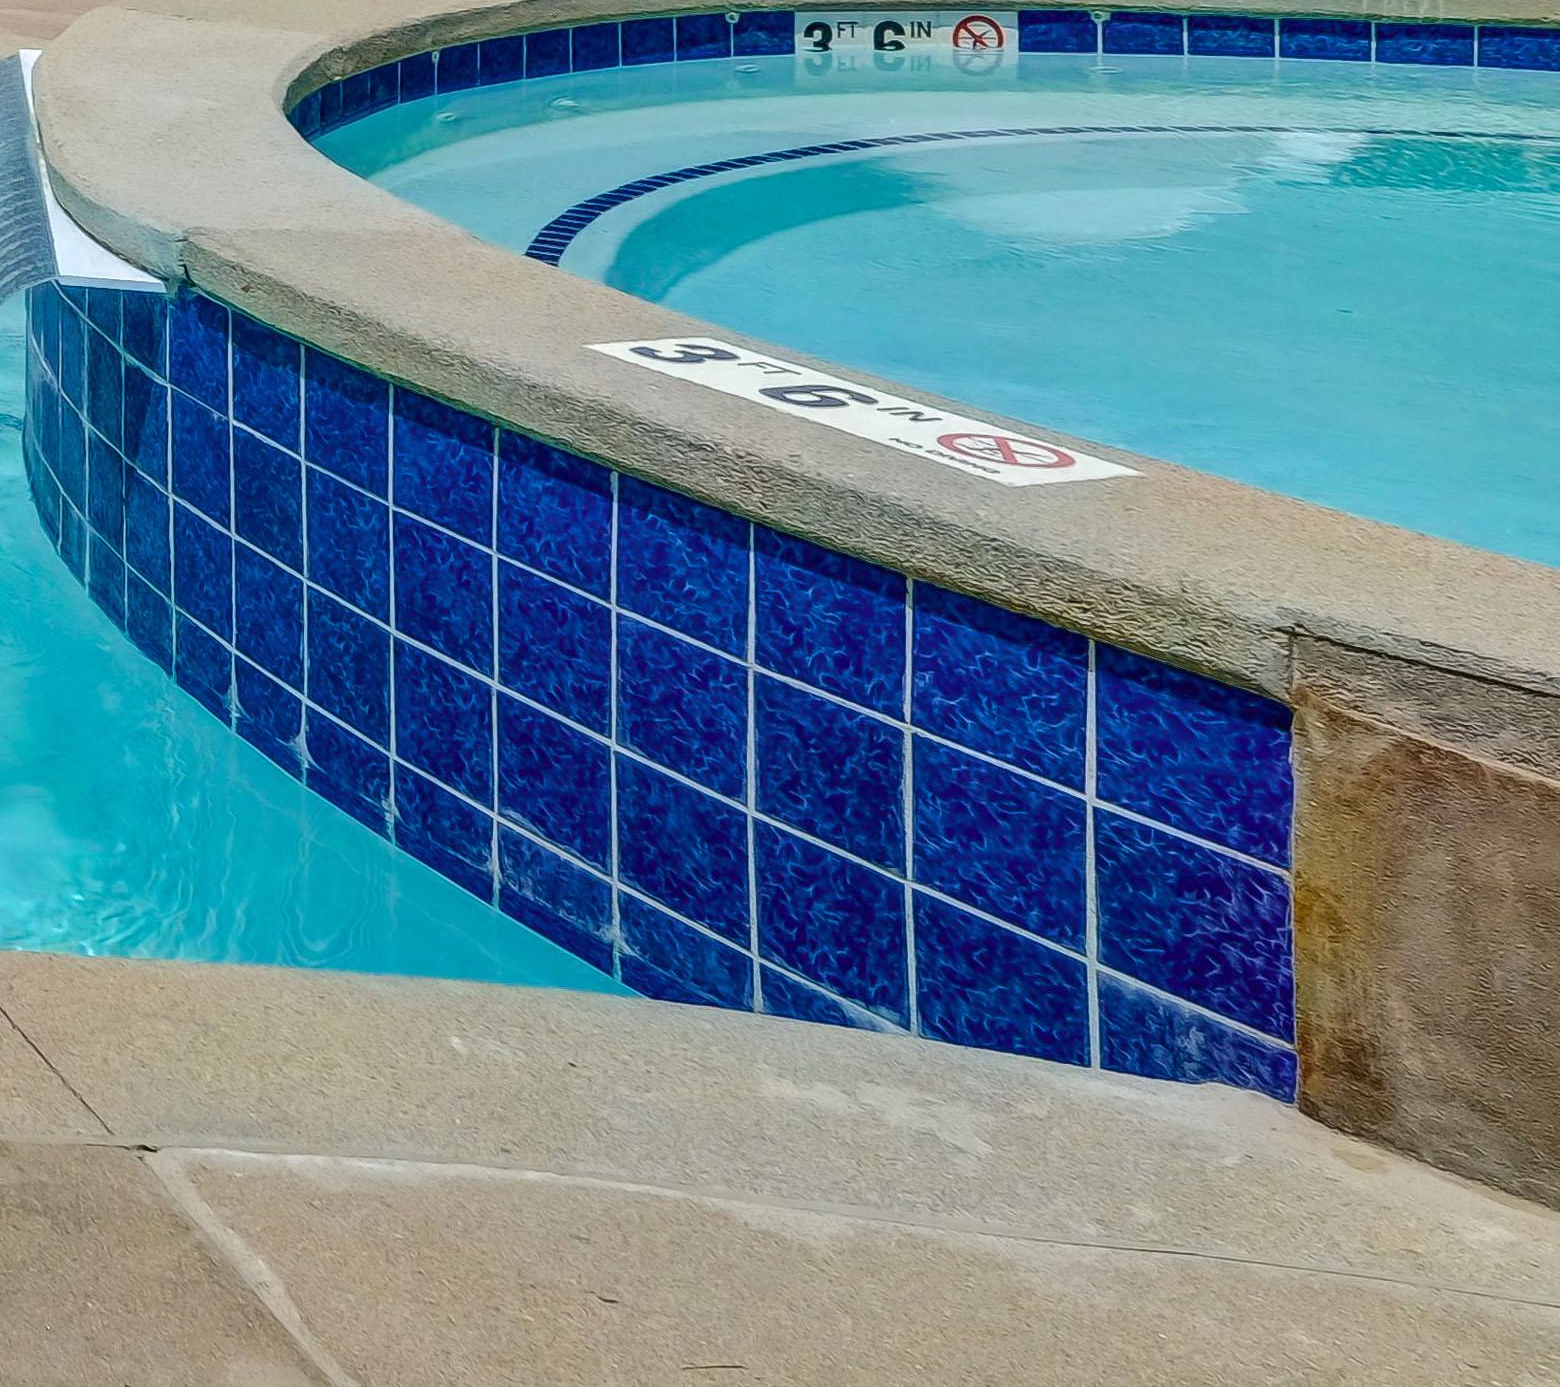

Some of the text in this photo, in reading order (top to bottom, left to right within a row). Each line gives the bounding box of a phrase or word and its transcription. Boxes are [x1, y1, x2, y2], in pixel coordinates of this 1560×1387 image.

[804, 20, 932, 52] 3 FT 6 IN
[628, 343, 944, 423] 3 FT 6 IN
